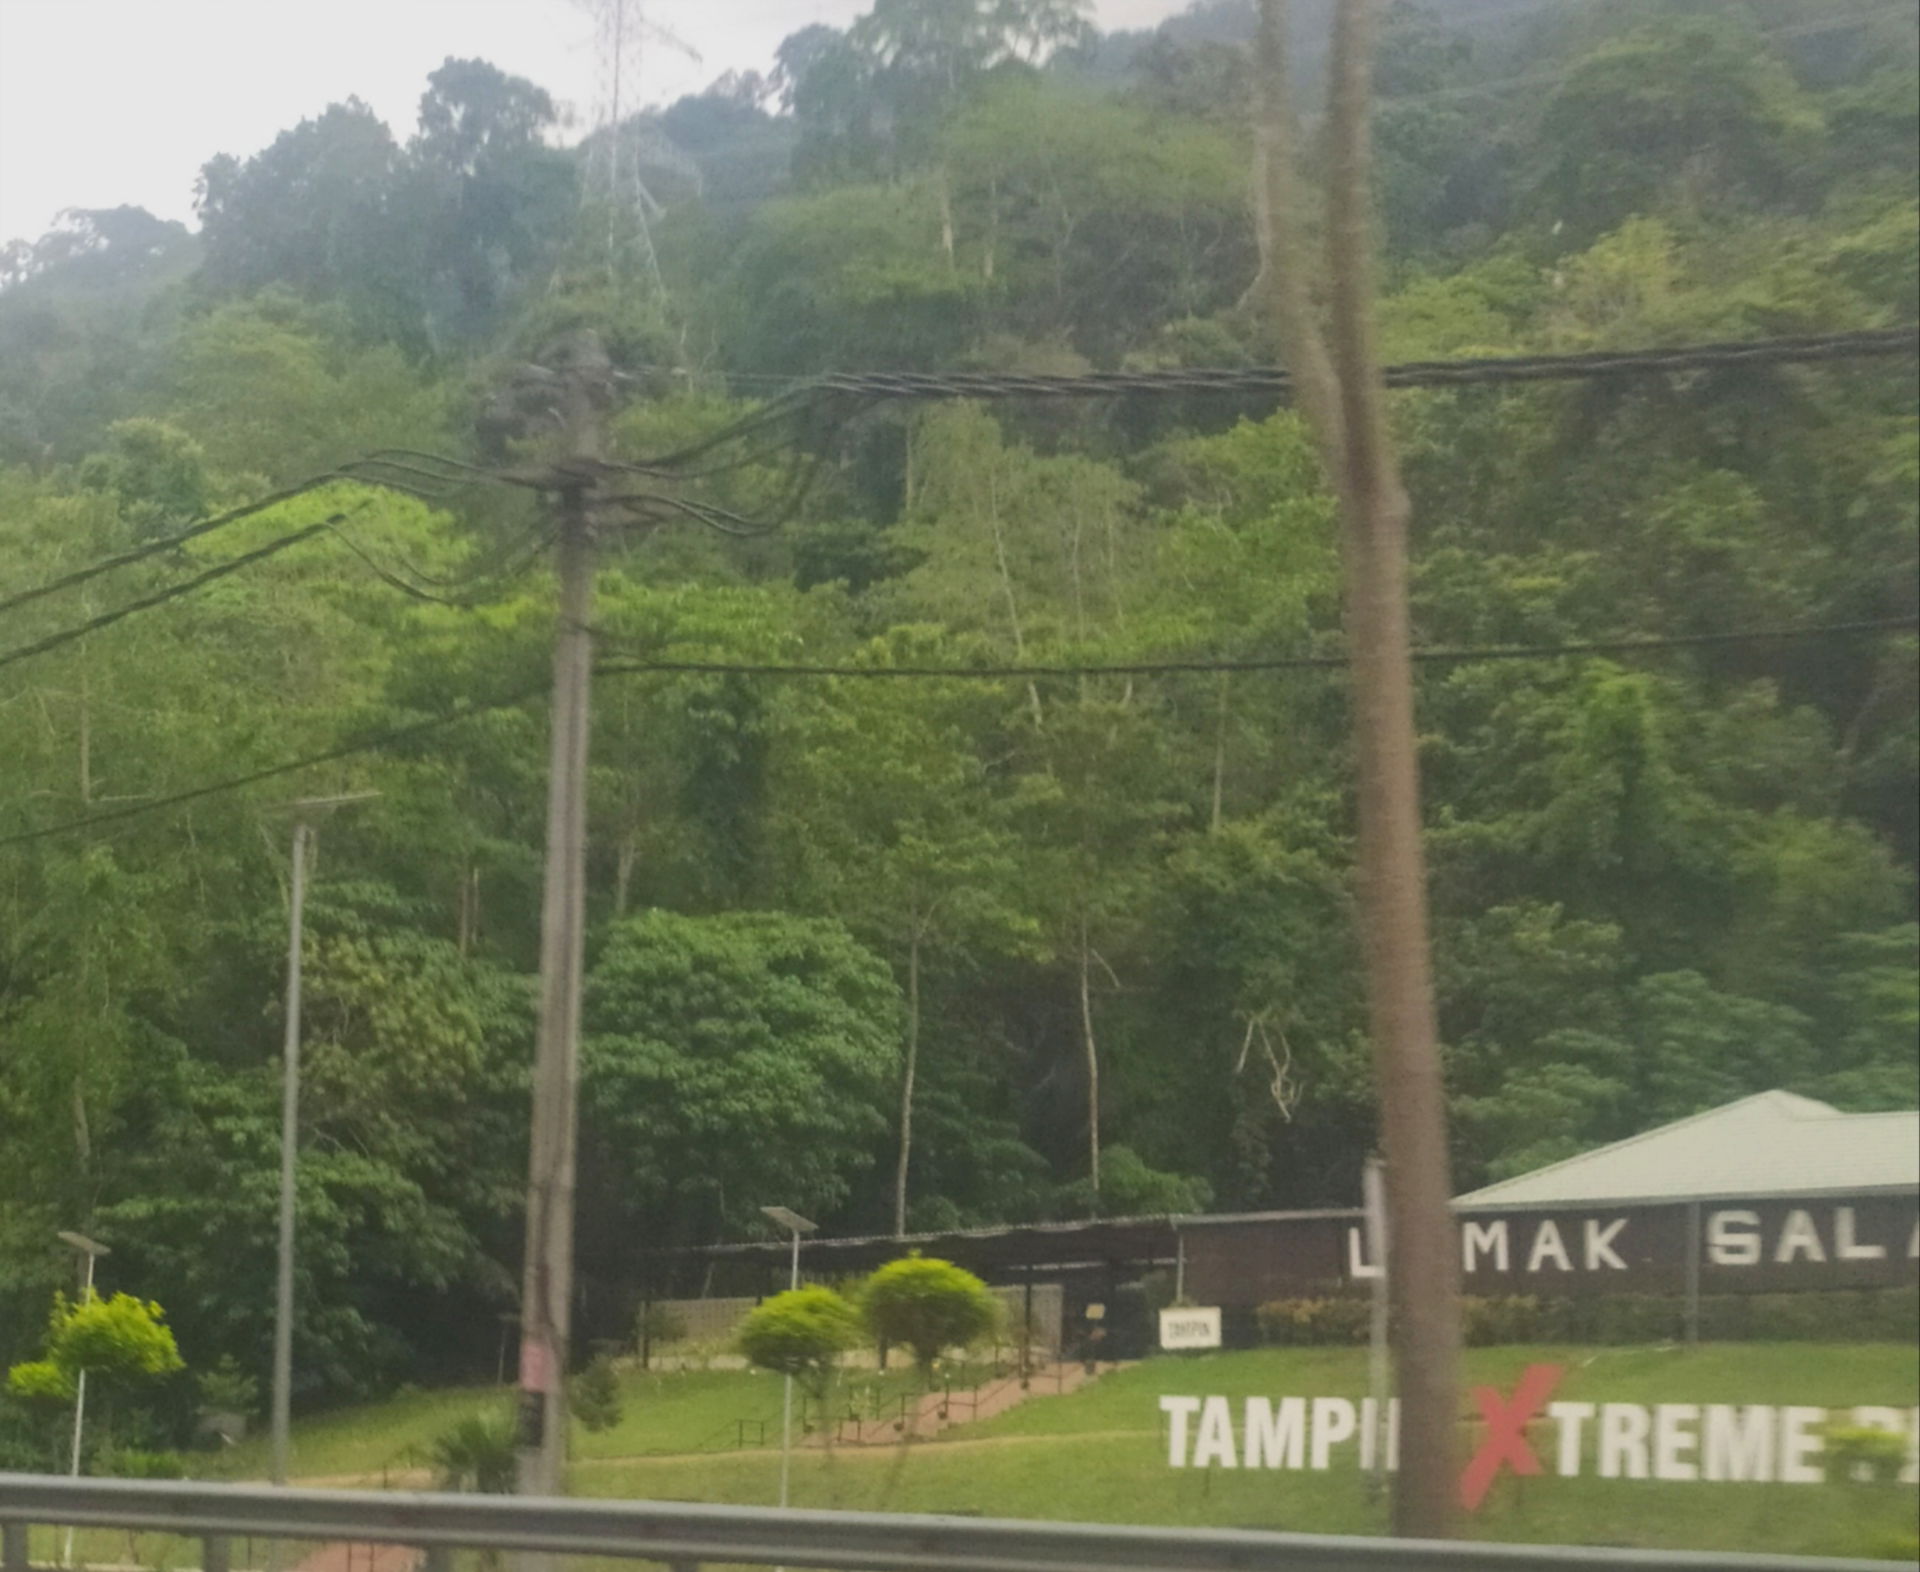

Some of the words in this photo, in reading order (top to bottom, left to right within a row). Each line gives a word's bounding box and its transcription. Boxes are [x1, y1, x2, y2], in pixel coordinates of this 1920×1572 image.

[1349, 1218, 1628, 1277] LMAK
[1708, 1207, 1919, 1265] SAL
[1159, 1395, 1400, 1470] TAMPI
[1458, 1363, 1826, 1511] XTREME
